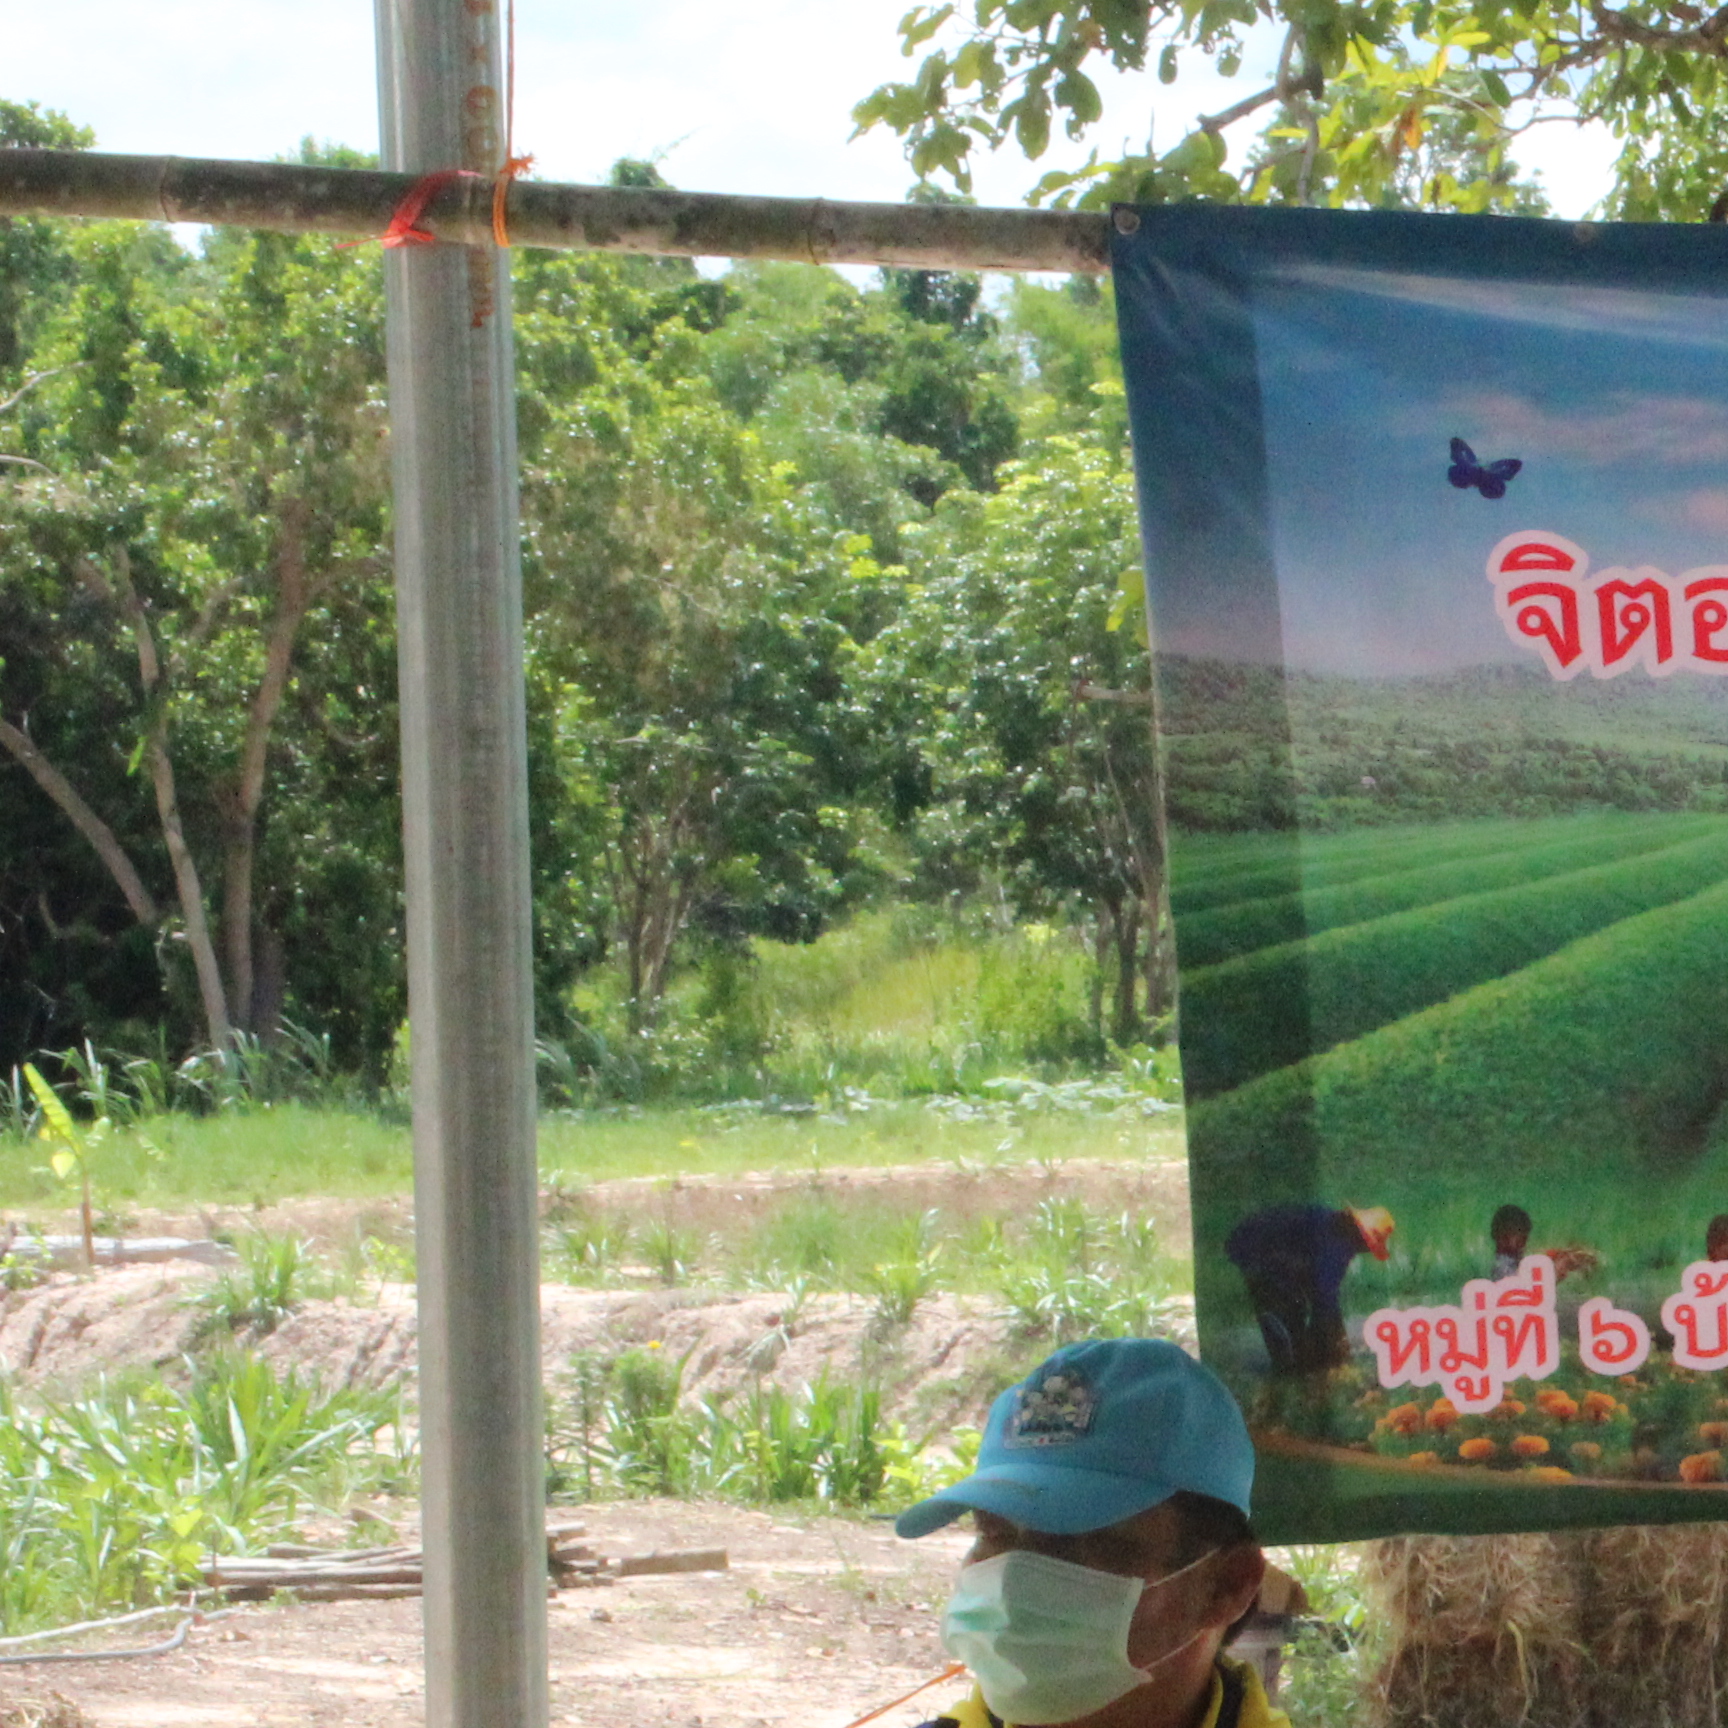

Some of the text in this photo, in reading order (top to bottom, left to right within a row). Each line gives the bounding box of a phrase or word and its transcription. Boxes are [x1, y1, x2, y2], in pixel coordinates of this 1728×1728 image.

[1374, 1266, 1551, 1402] หมู่ที่
[1590, 1309, 1640, 1364] ๖
